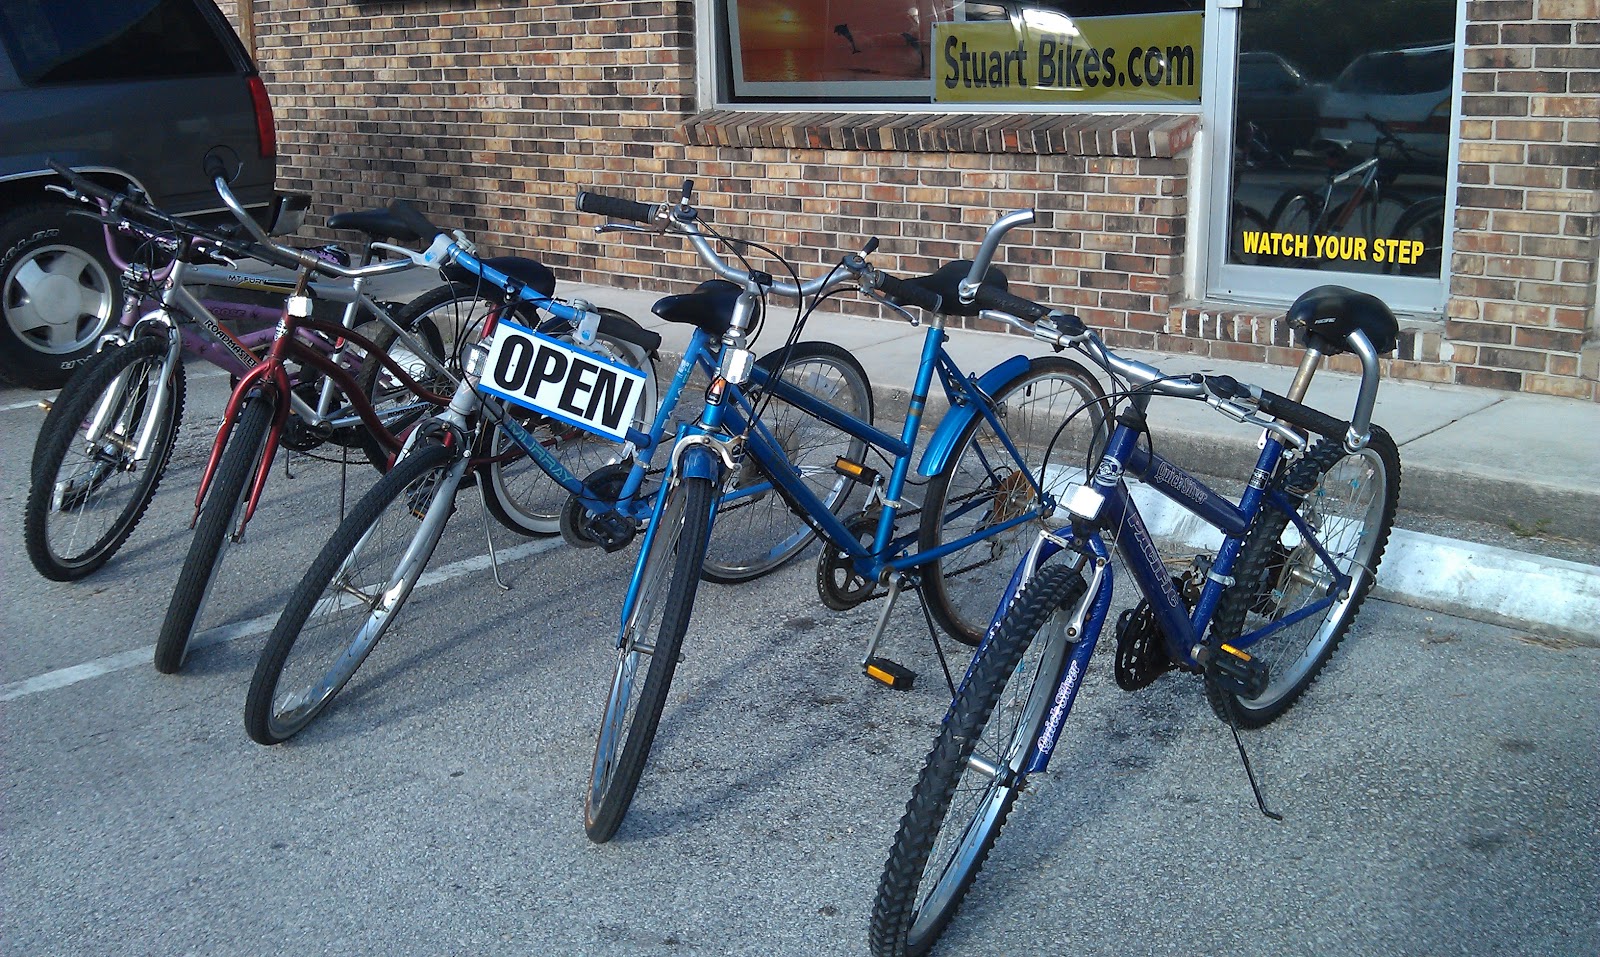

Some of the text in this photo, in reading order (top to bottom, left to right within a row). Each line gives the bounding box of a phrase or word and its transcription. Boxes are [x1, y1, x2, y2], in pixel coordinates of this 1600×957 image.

[944, 34, 1194, 88] Stuart Bikes.com
[1243, 231, 1424, 265] WATCH YOUR STEP
[494, 334, 634, 430] OPEN
[509, 421, 573, 482] MURRAY
[1127, 512, 1179, 608] PACIFIC
